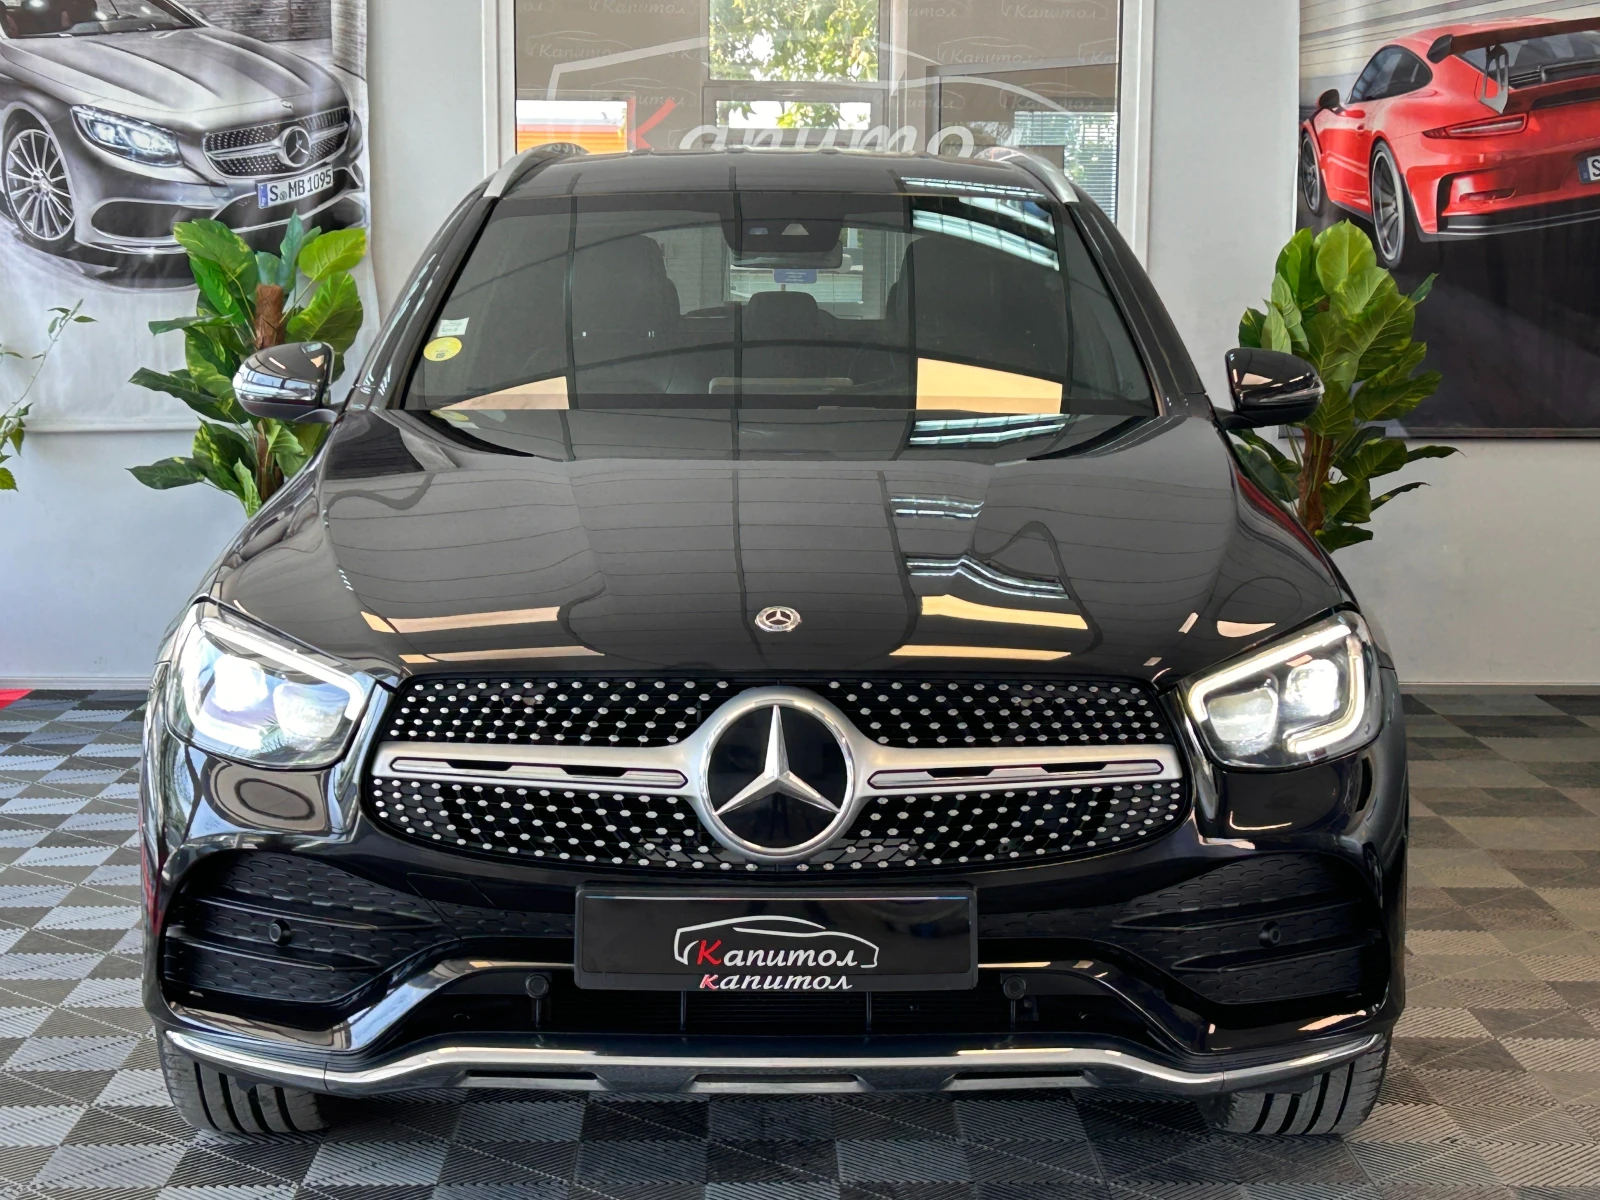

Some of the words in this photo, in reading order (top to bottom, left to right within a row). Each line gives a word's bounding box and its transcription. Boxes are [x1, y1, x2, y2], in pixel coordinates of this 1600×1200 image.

[269, 185, 279, 202] S
[288, 179, 305, 199] MB
[307, 169, 332, 193] 1095
[697, 939, 858, 967] Капитол
